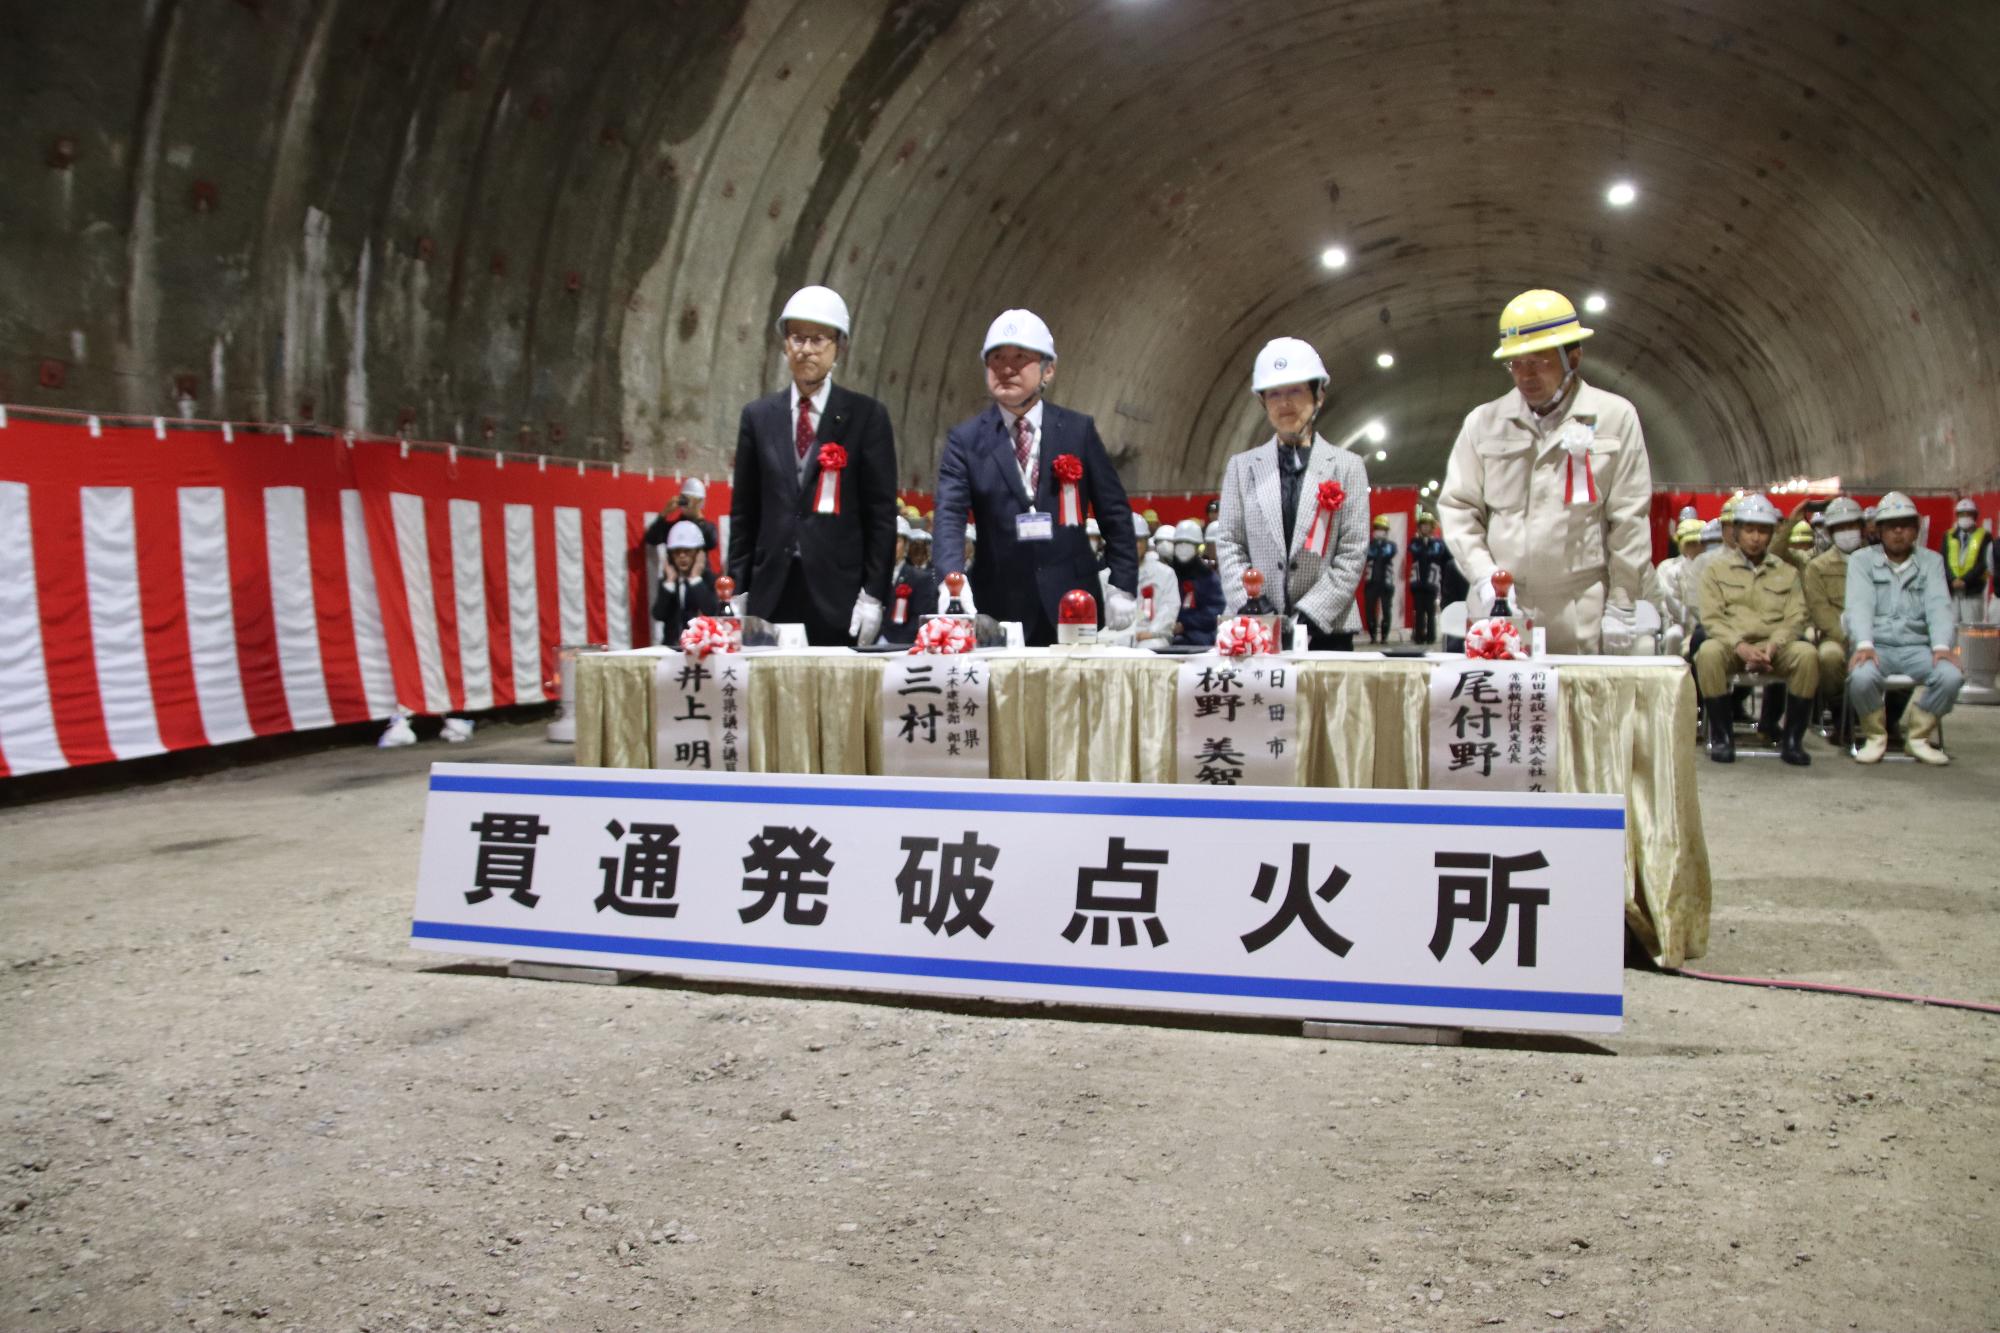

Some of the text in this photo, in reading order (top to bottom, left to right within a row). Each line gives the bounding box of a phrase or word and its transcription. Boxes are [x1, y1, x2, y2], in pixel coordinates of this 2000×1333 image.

[674, 664, 712, 769] 井上明
[898, 665, 944, 743] 三村
[963, 667, 979, 748] 大分県
[1266, 668, 1287, 759] 日田市
[1448, 670, 1502, 777] 尾付野
[464, 812, 1550, 967] 貫通発破点火所
